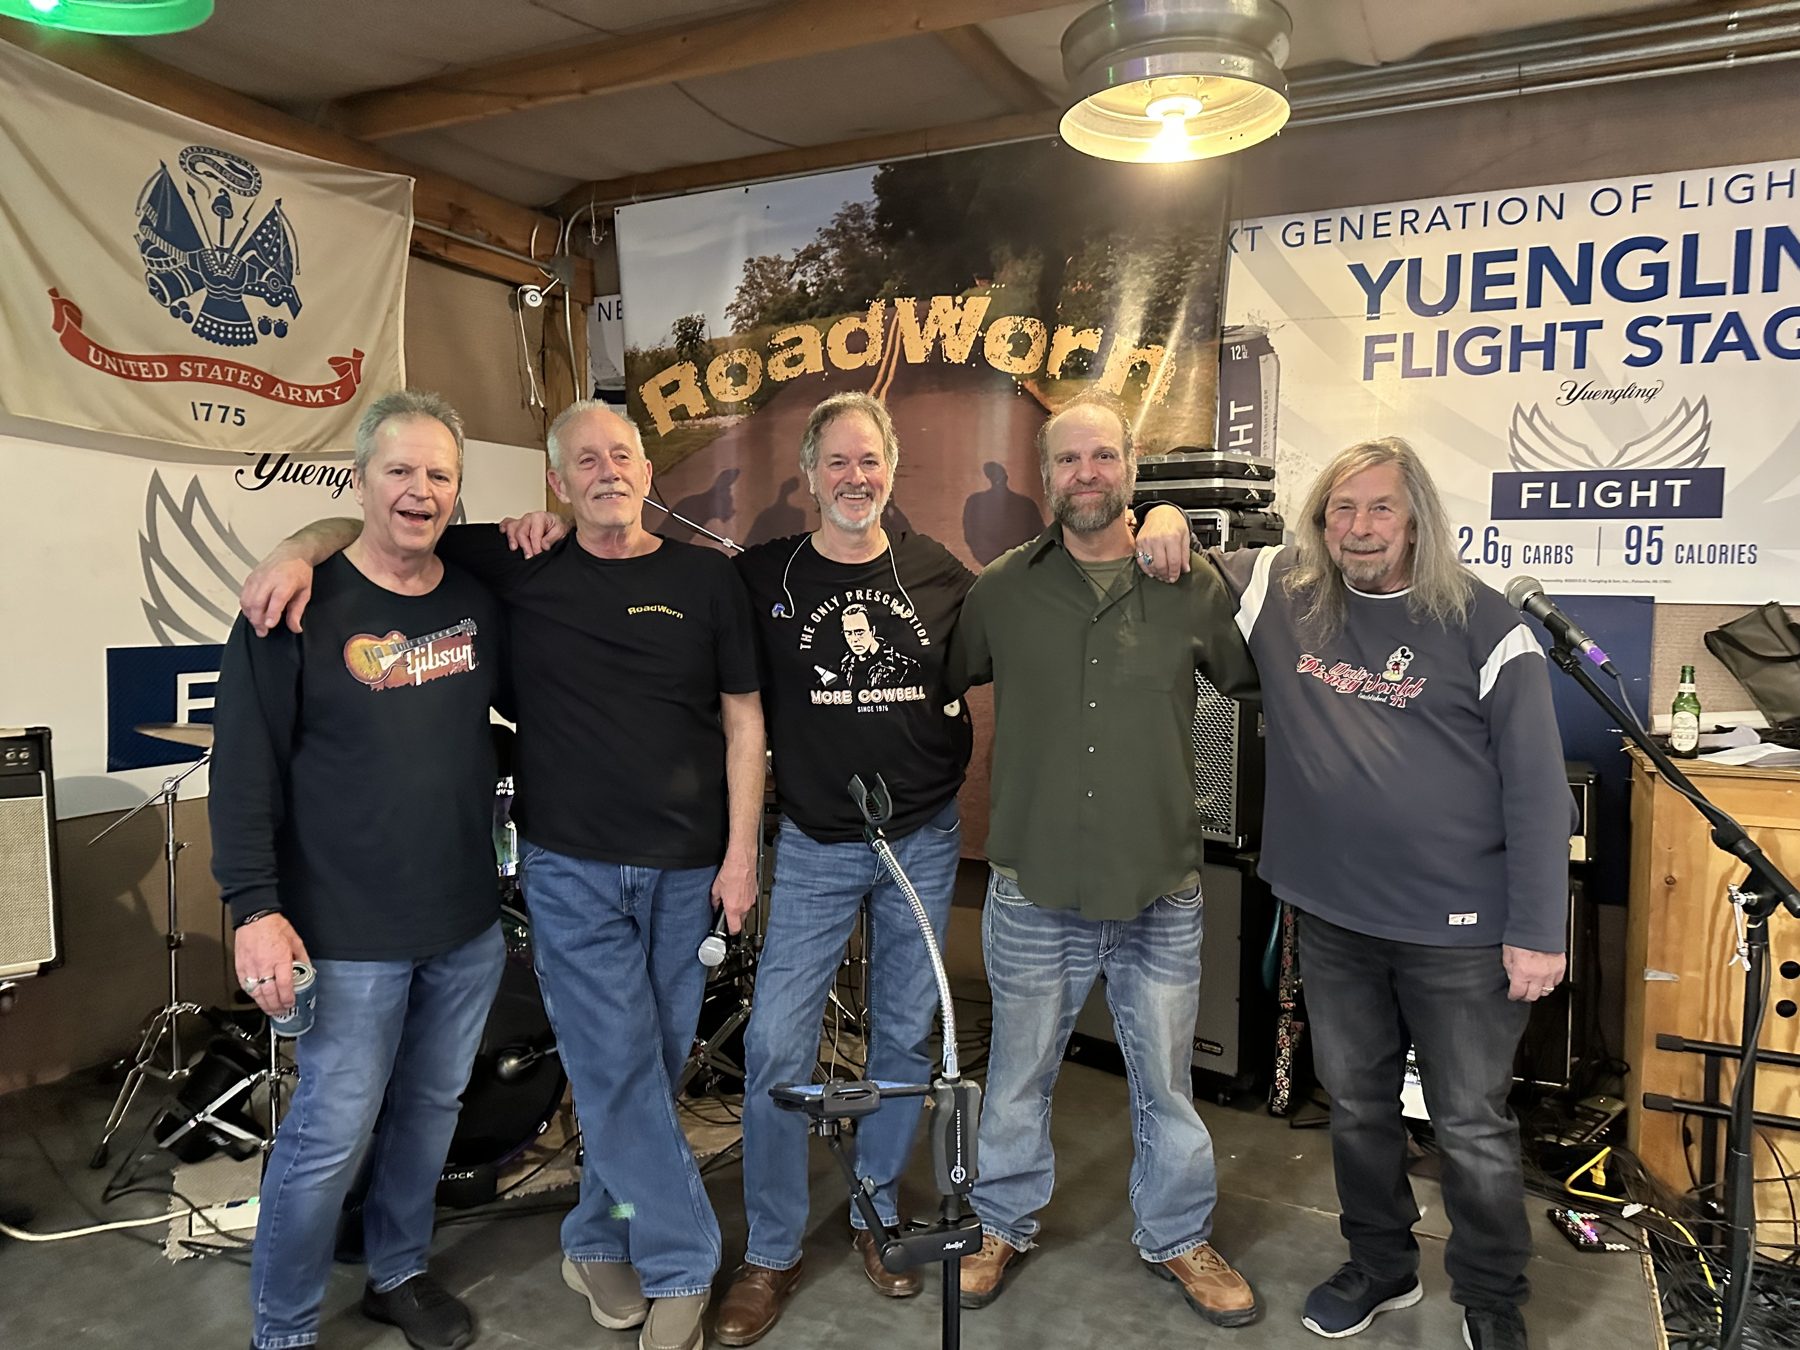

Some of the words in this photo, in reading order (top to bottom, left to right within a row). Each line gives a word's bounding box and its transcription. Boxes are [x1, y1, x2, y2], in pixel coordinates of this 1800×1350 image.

[1281, 193, 1564, 248] GENERATION
[1590, 183, 1653, 217] OF
[1679, 168, 1796, 209] LIGH
[1347, 225, 1800, 320] YUENGLIN
[1230, 344, 1242, 360] 12
[1362, 319, 1604, 381] FLIGHT
[1621, 306, 1800, 368] STAG
[87, 345, 168, 379] UNITED
[179, 361, 263, 390] STATES
[270, 382, 342, 403] ARMY
[638, 295, 1177, 437] RoadWorn
[191, 401, 246, 427] 1775
[1555, 380, 1664, 406] Yuengling
[235, 452, 354, 499] Yueng
[1520, 479, 1691, 509] FLIGHT
[1457, 525, 1512, 568] 2.6g
[1522, 545, 1573, 564] CARBS
[1624, 525, 1664, 565] 95
[1675, 543, 1758, 564] CALORIES
[627, 605, 684, 619] RoadWorn
[800, 624, 816, 650] THE
[810, 596, 840, 623] ONLY
[406, 642, 476, 686] Gibson
[1296, 654, 1363, 693] Disney
[1360, 673, 1427, 698] World
[810, 690, 853, 704] MORE
[858, 686, 926, 704] COWBELL
[857, 705, 874, 713] SINCE
